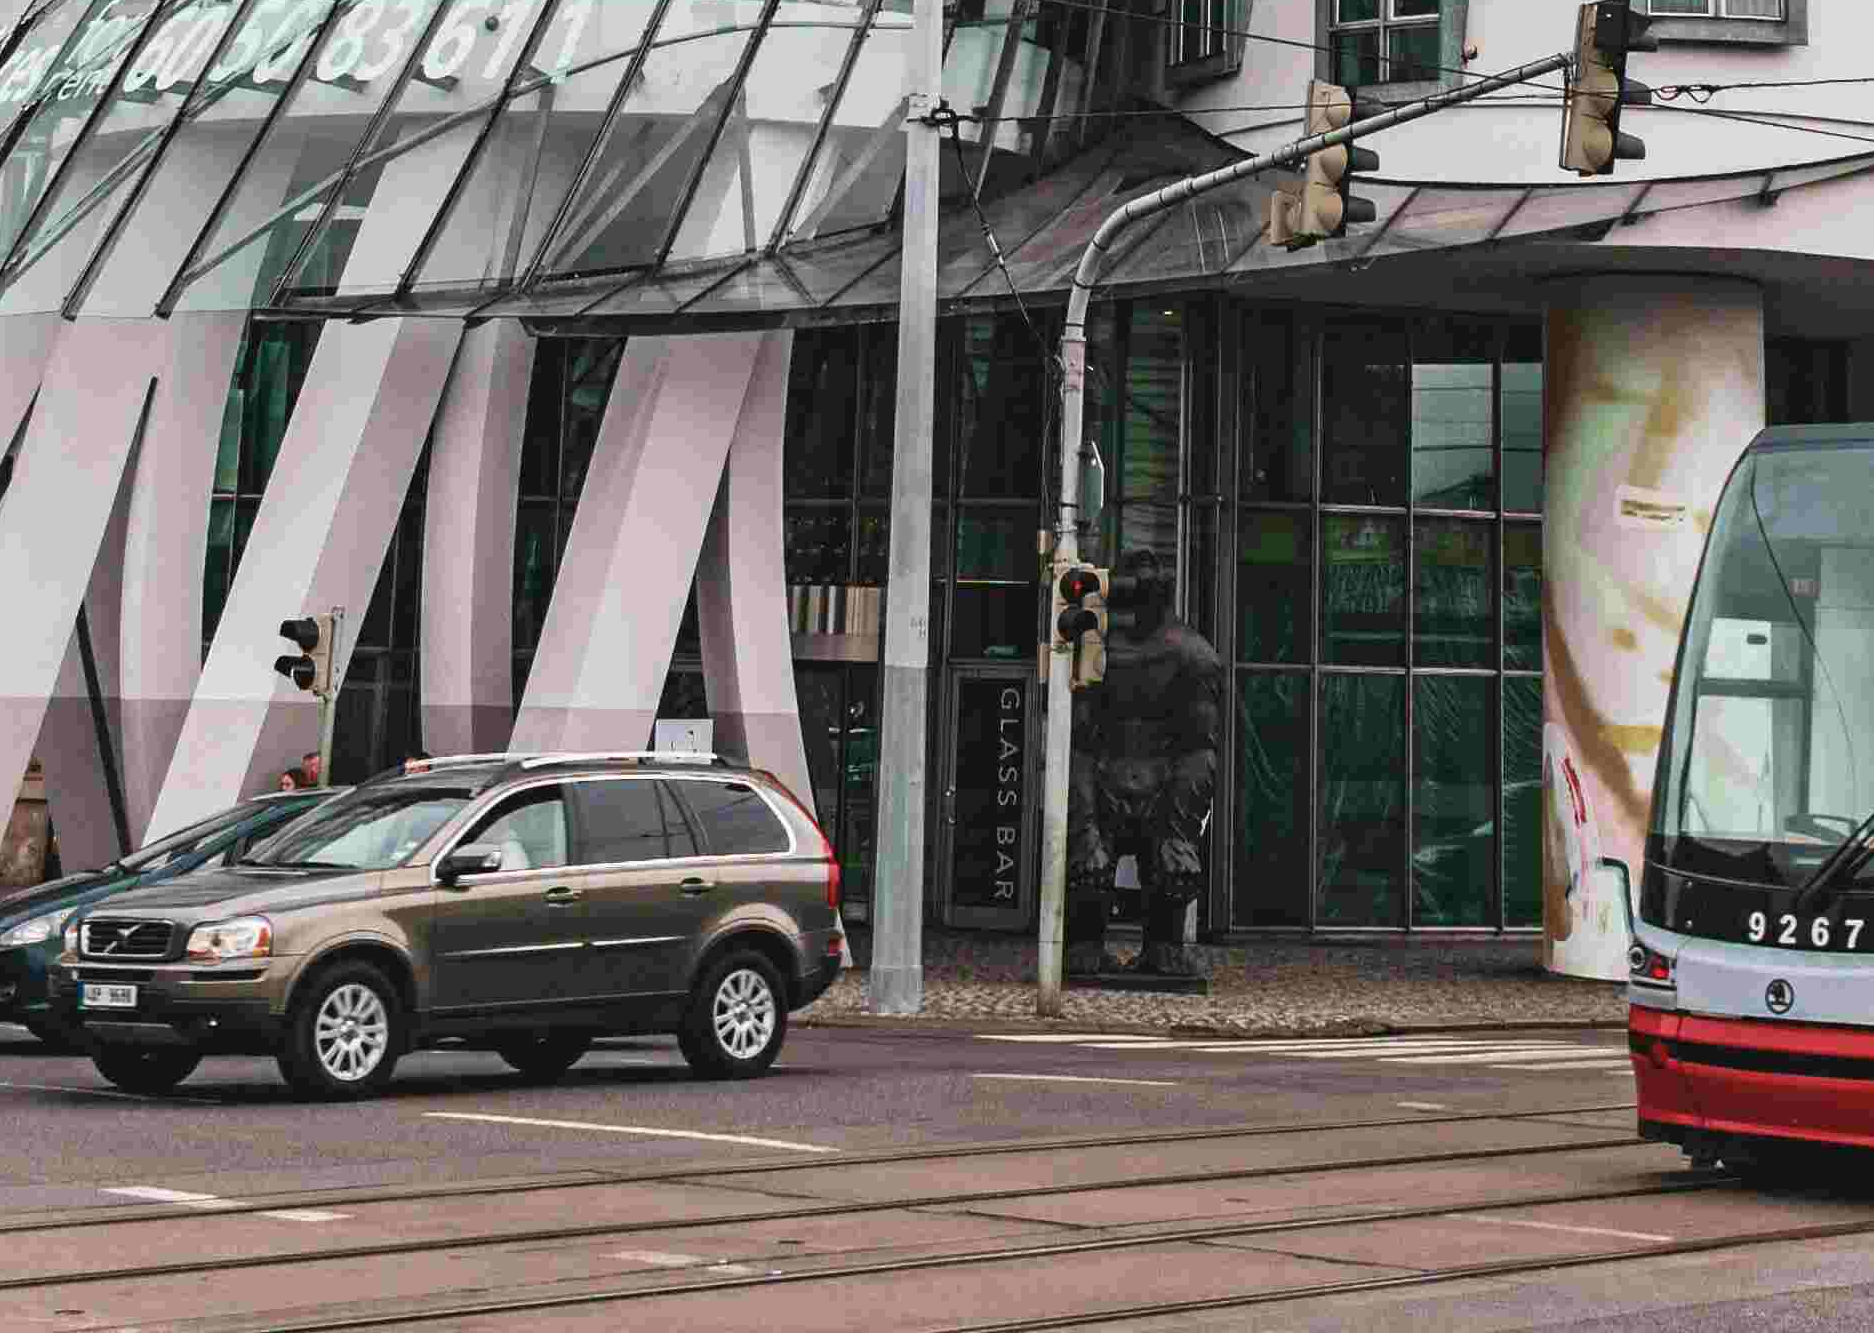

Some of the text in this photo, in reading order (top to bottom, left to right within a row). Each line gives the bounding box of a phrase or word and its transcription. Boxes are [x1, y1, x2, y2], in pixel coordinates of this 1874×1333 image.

[993, 687, 1021, 900] GLASS BAR
[1748, 910, 1865, 949] 9267
